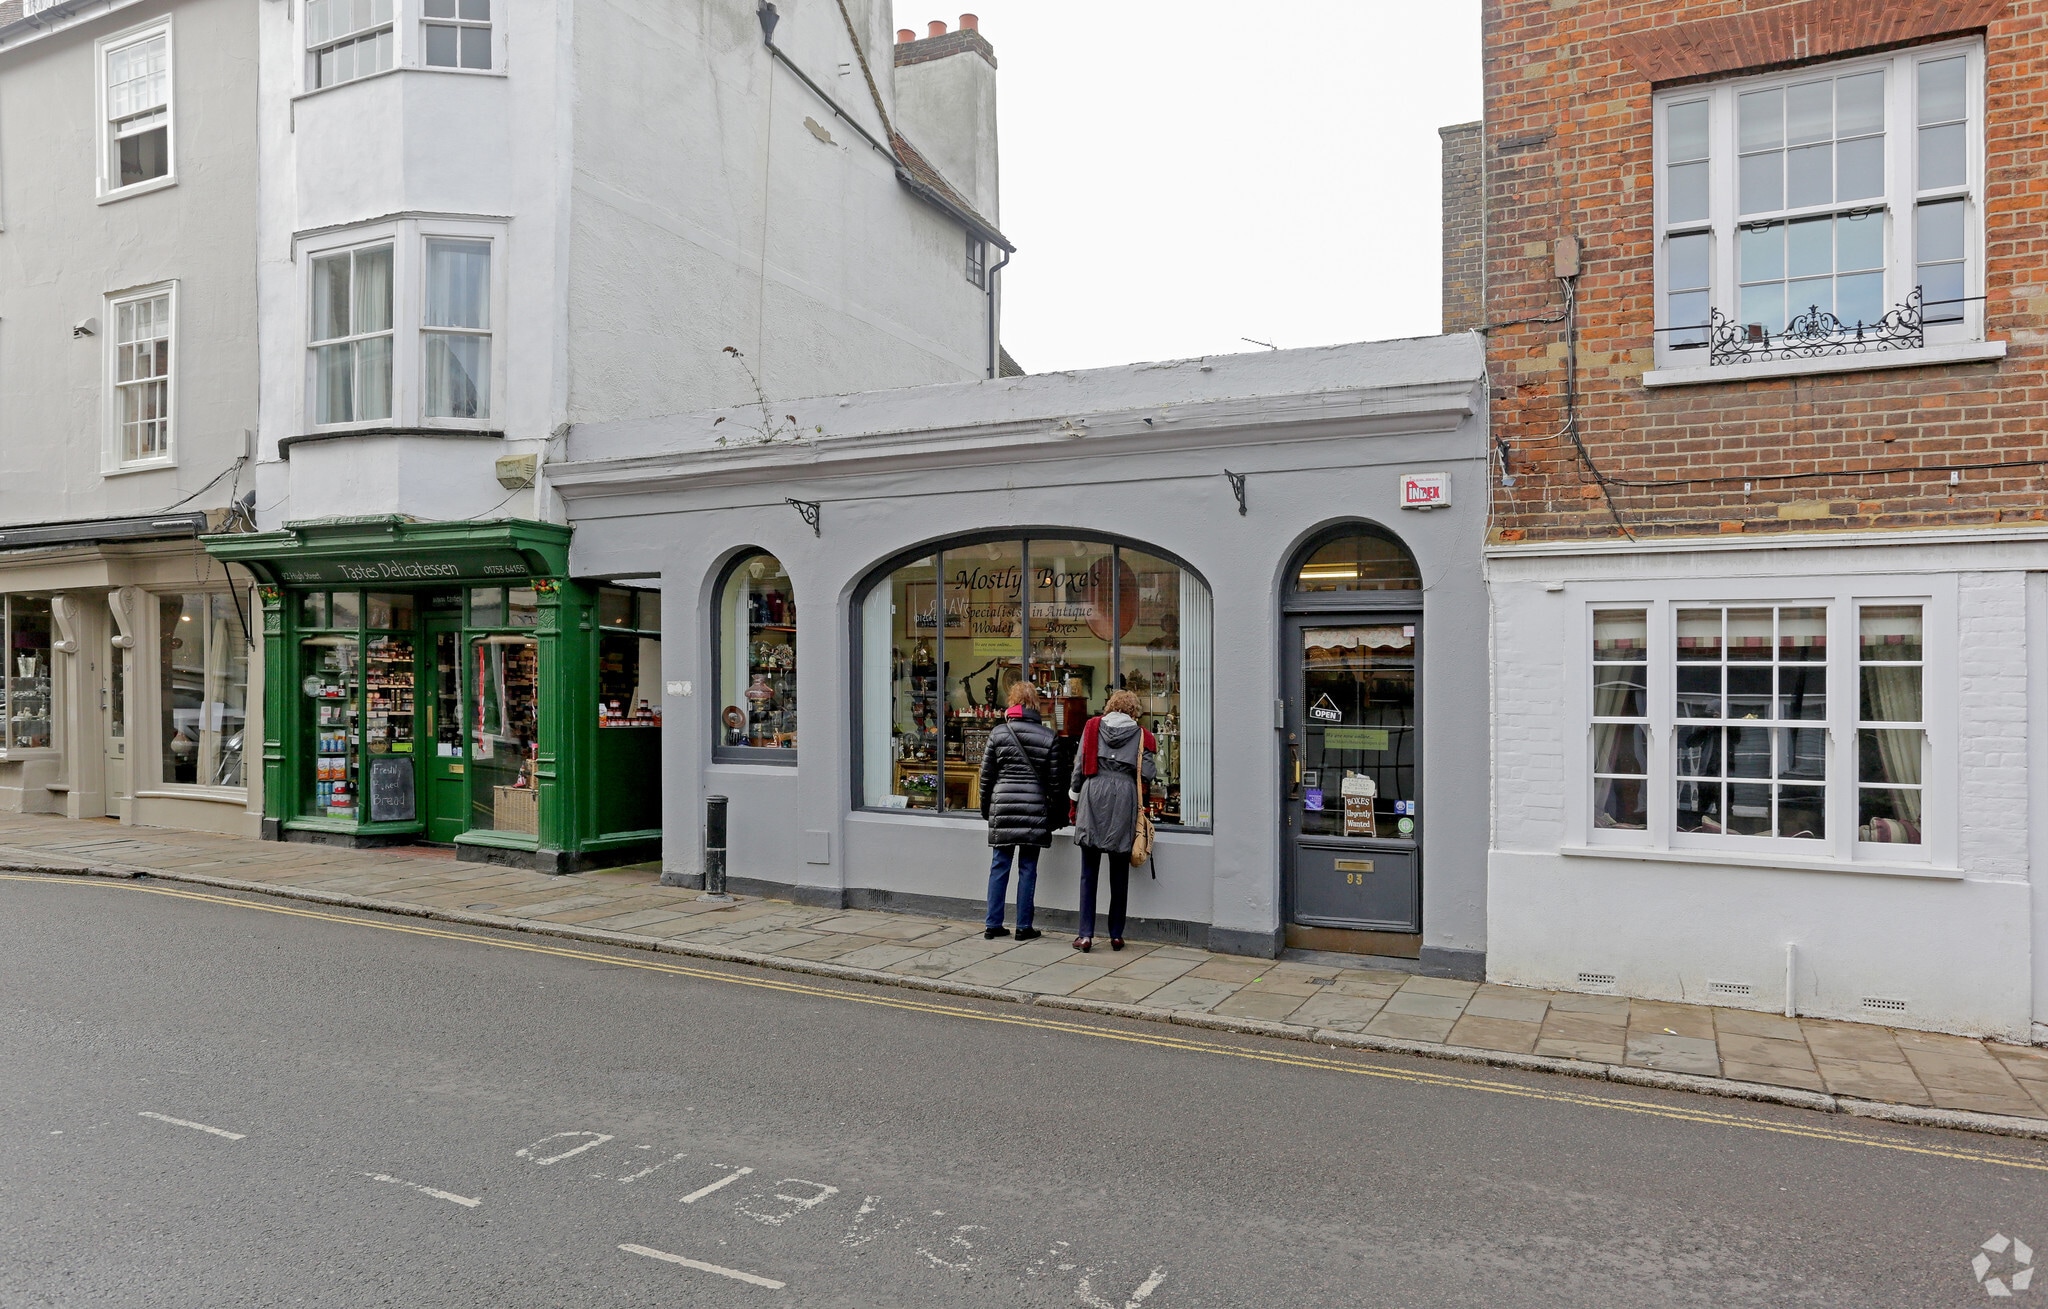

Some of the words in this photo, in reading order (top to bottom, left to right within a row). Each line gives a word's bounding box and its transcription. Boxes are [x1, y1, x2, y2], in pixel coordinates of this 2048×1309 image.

[338, 563, 378, 580] Tastes
[378, 560, 460, 578] Delicatessen
[483, 565, 504, 575] 01753
[289, 571, 304, 583] High
[303, 571, 322, 580] Street
[955, 565, 1023, 598] Mostly
[1037, 567, 1101, 594] Boxes
[963, 604, 1022, 622] Specialists
[1032, 605, 1043, 618] in
[1045, 605, 1093, 621] Antique
[972, 620, 1014, 633] Wooden
[1045, 621, 1078, 635] Boxes
[1315, 709, 1337, 720] OPEN
[373, 764, 401, 779] Freshly
[373, 792, 405, 806] Bread
[1347, 797, 1370, 806] BOXES
[1347, 809, 1372, 819] Urgently
[1347, 820, 1371, 829] Wanted
[1346, 873, 1363, 885] 93
